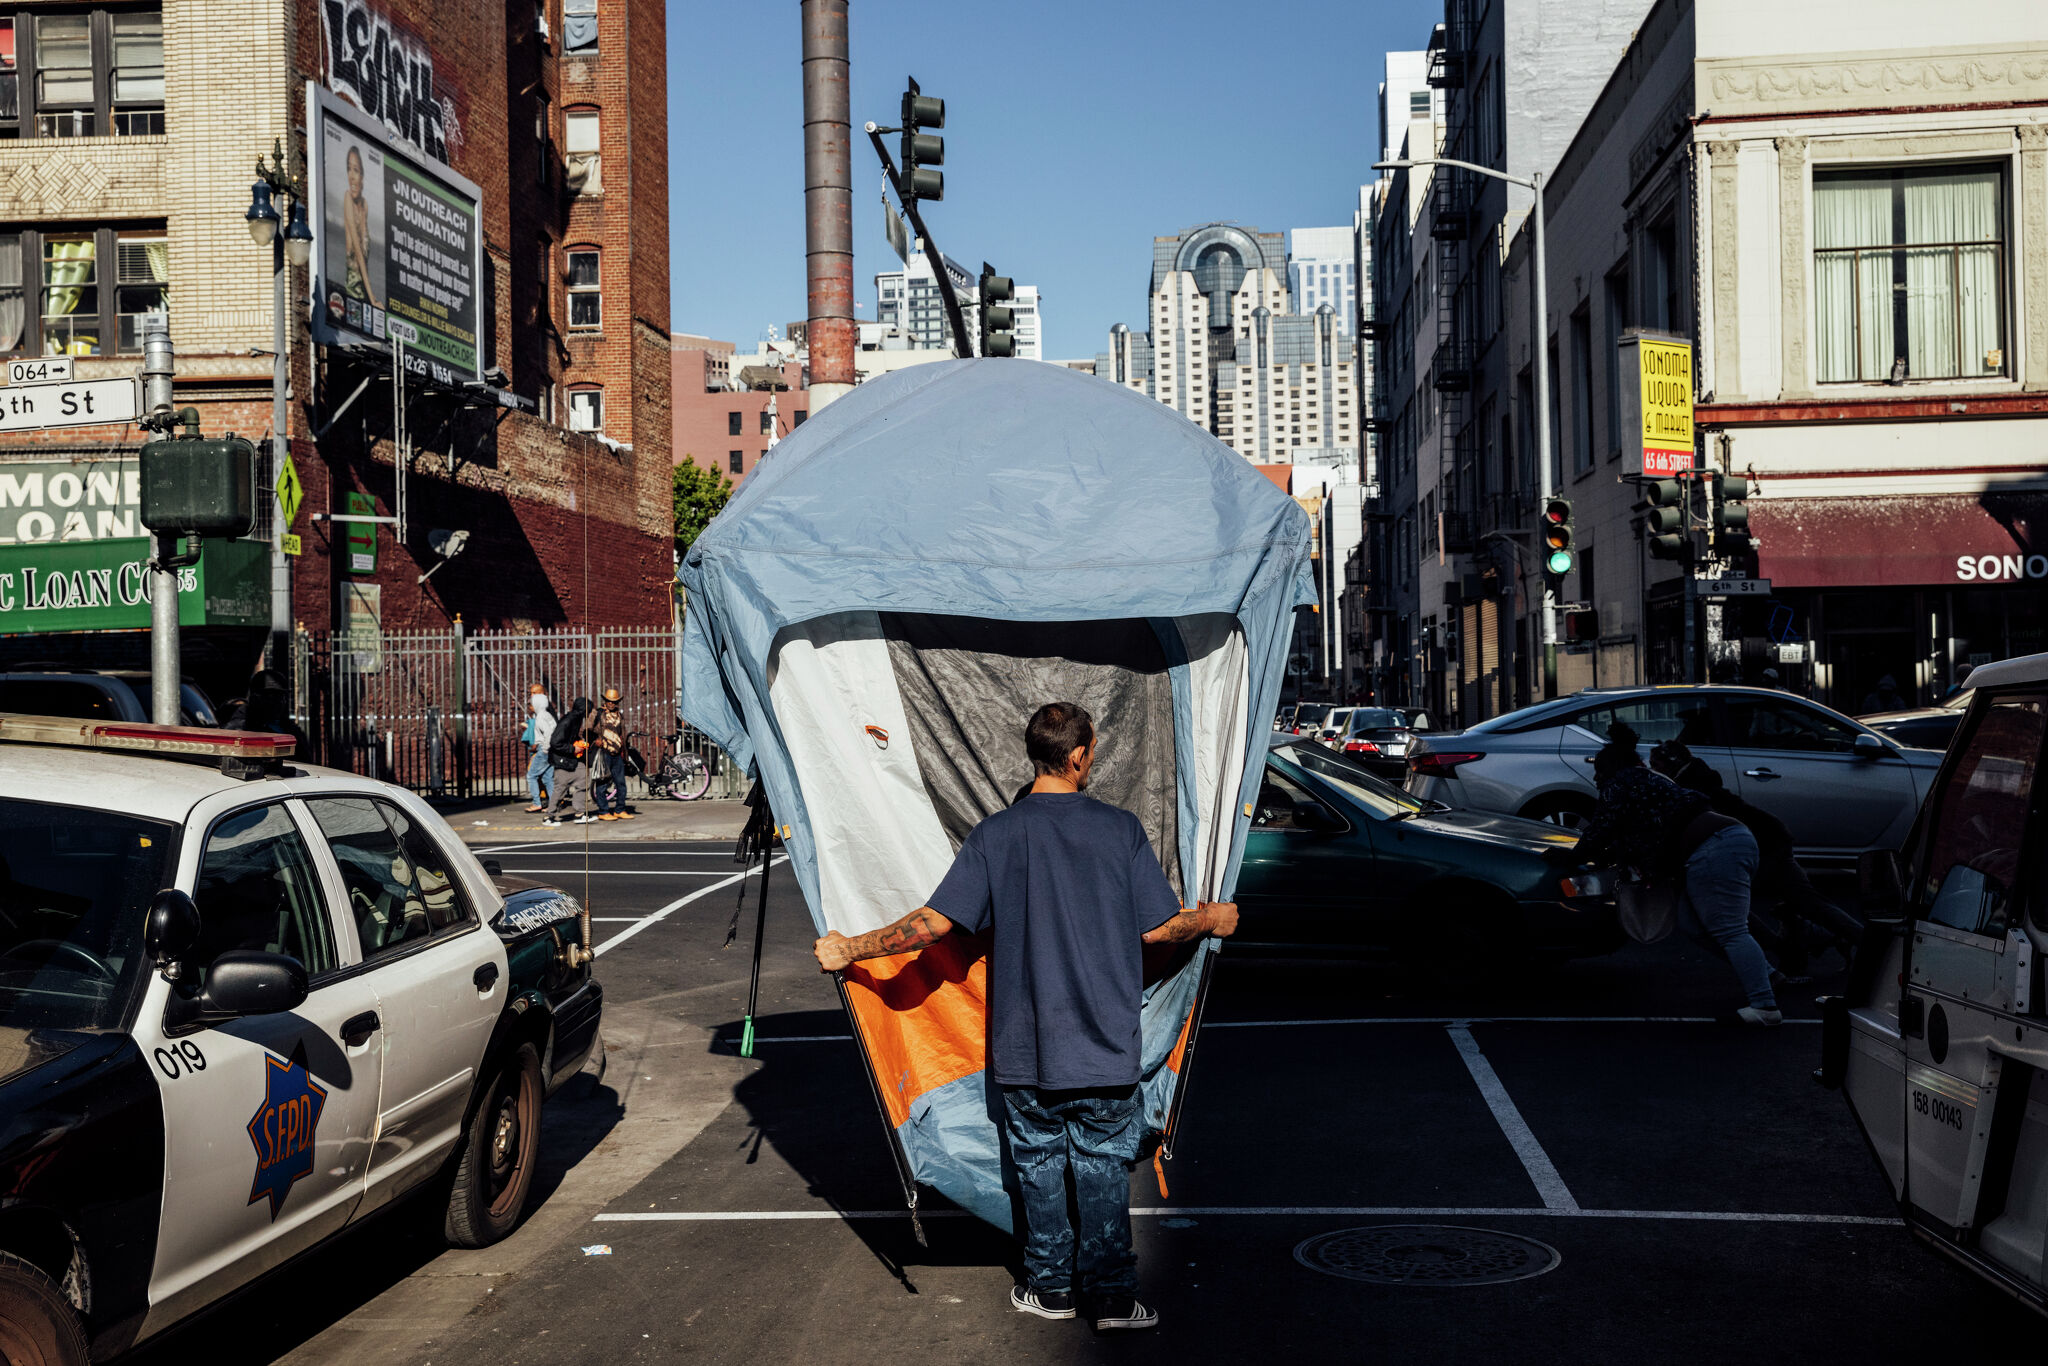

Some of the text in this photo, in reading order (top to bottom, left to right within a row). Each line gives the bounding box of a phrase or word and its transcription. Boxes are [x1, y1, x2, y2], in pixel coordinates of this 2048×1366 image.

[393, 180, 467, 233] JN OUTREACH
[396, 200, 466, 251] FOUNDATION
[14, 363, 47, 381] 064
[1643, 350, 1688, 378] SONOMA
[61, 390, 94, 416] St
[1648, 380, 1686, 407] LIQUOR
[1656, 412, 1689, 436] MARKET
[1645, 452, 1691, 471] 65 6th STREET
[0, 471, 140, 508] MONE
[0, 510, 150, 545] OAN
[1957, 554, 2048, 580] SONO
[22, 568, 112, 610] LOAN
[1712, 582, 1755, 591] 6th St
[1781, 652, 1799, 660] EBT
[509, 898, 570, 934] EMERGENCY
[154, 1040, 207, 1080] 019
[1913, 1090, 1962, 1130] 158 00143
